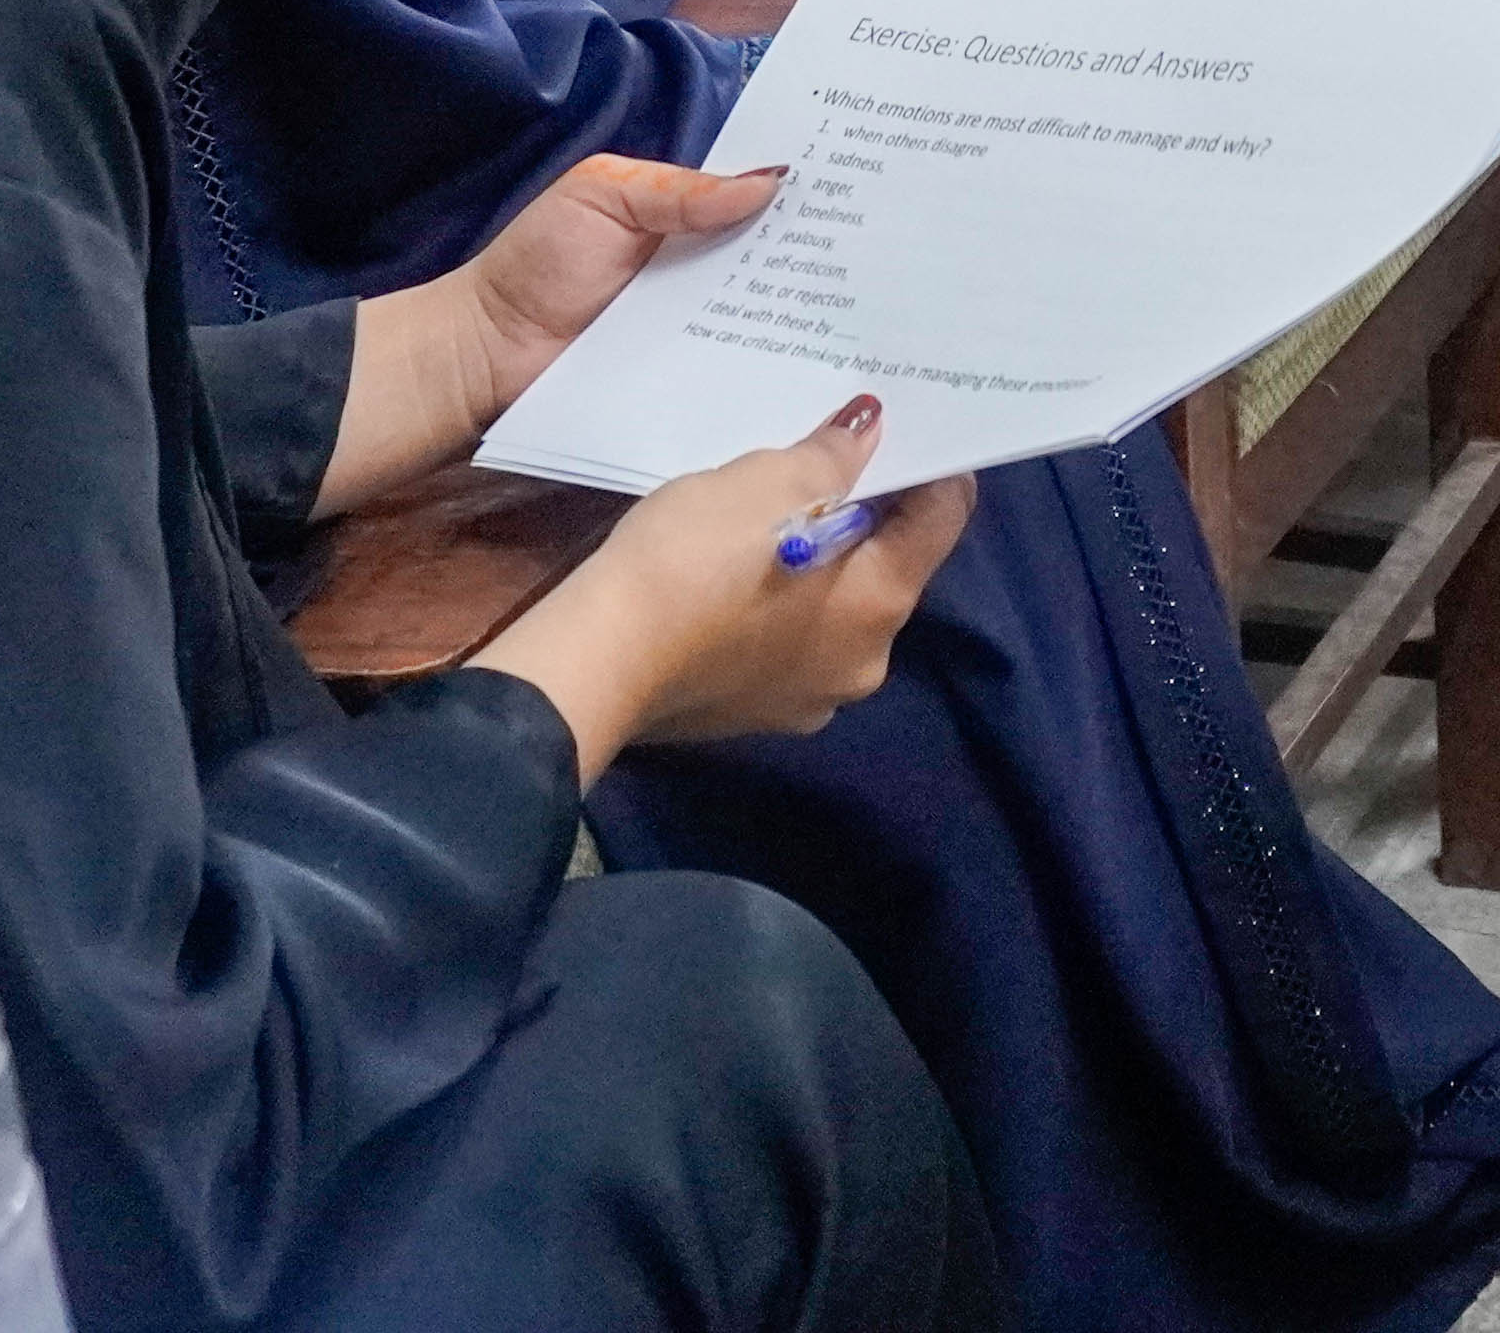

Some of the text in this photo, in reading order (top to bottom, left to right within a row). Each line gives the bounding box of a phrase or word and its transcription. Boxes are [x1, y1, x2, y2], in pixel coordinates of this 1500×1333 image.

[849, 17, 1254, 84] Exercise: Questions and Answers
[823, 86, 1273, 160] Which emotions are most difficult to manage and why?
[844, 126, 883, 144] when
[885, 133, 928, 151] others
[930, 137, 988, 158] disagree
[711, 300, 741, 318] deal
[742, 307, 774, 324] with
[775, 313, 814, 333] these
[815, 319, 834, 338] by
[777, 286, 793, 300] or
[794, 288, 855, 310] rejection
[683, 322, 715, 338] How
[715, 329, 742, 345] can
[742, 332, 792, 355] critical
[791, 343, 850, 371] thinking
[850, 354, 881, 374] help
[883, 363, 901, 377] us
[901, 361, 916, 379] in
